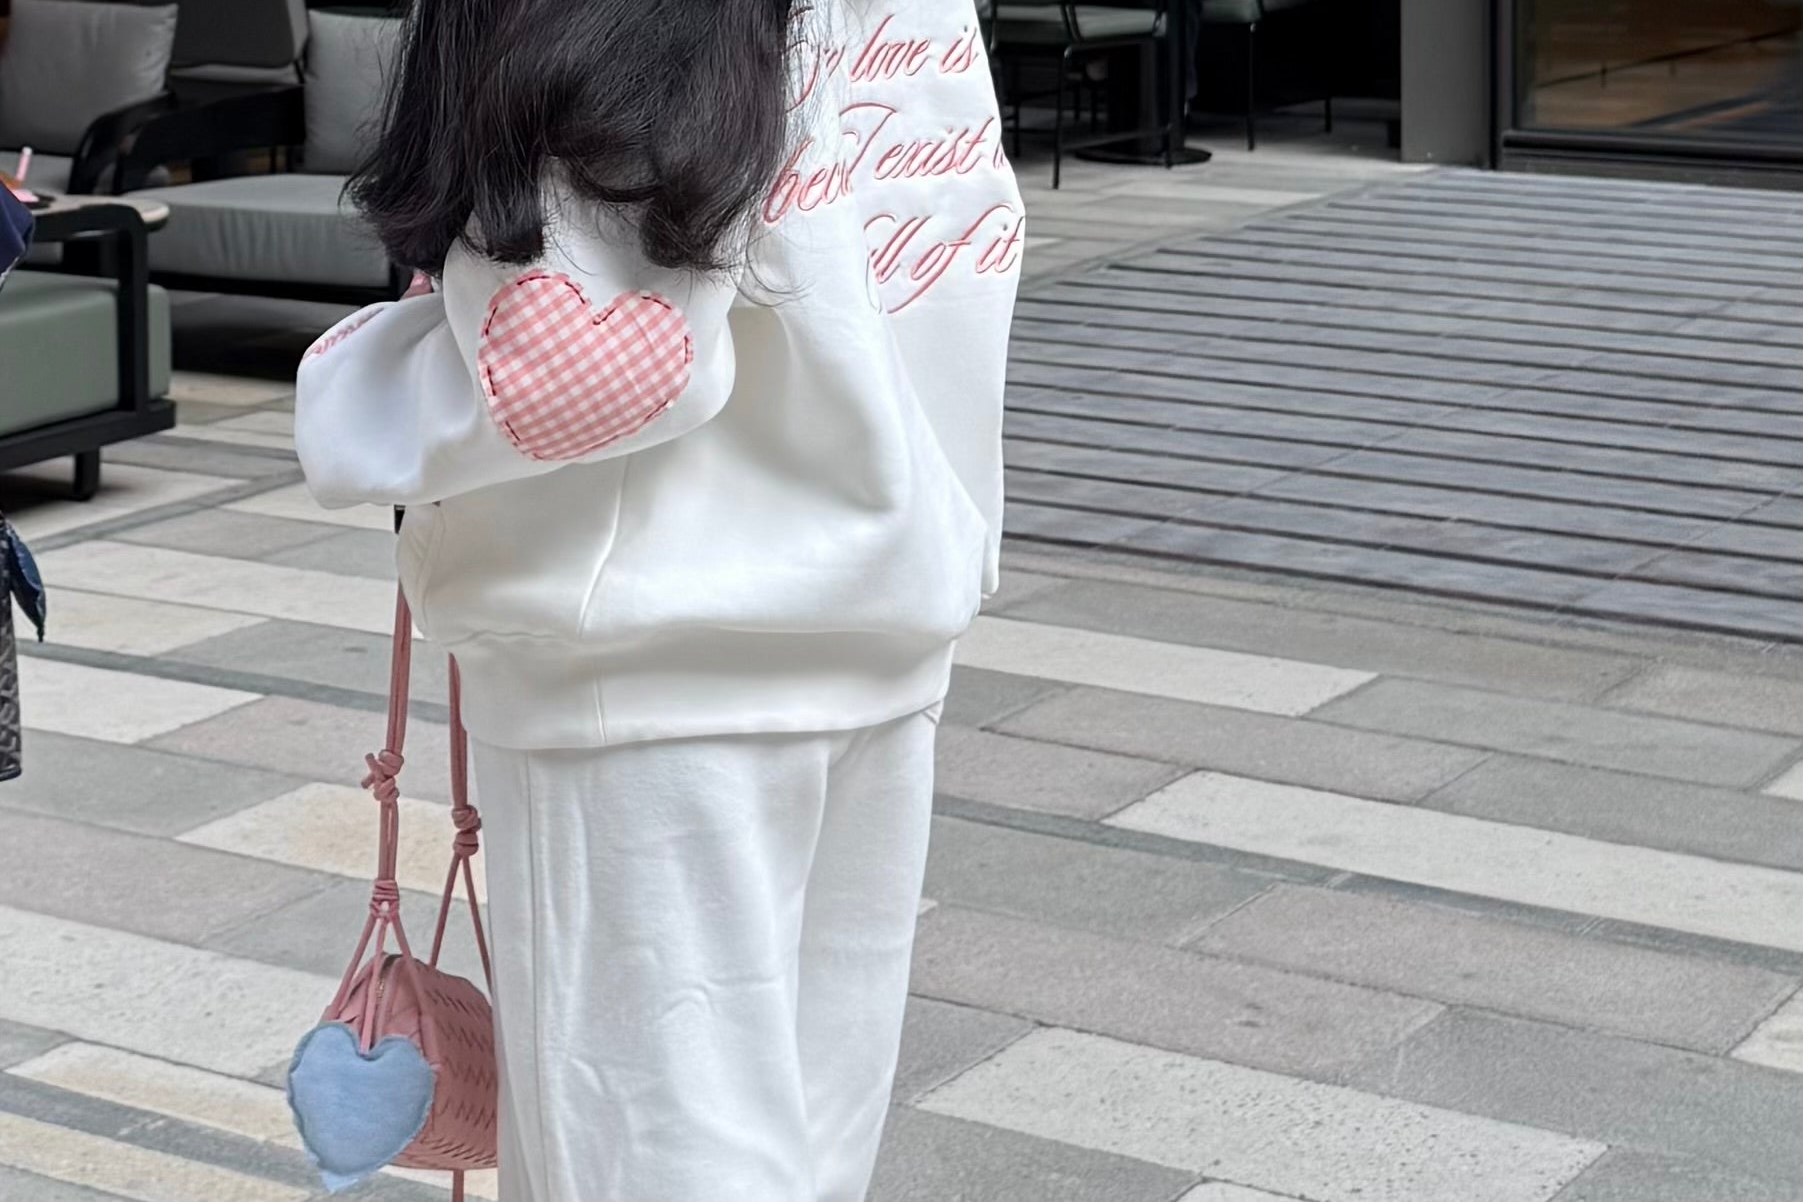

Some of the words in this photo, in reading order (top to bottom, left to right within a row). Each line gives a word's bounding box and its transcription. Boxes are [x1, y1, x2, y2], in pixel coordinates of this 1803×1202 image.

[849, 13, 930, 83] love
[938, 25, 978, 74] is
[873, 116, 997, 180] exist
[886, 202, 1014, 315] of
[974, 216, 1025, 274] it
